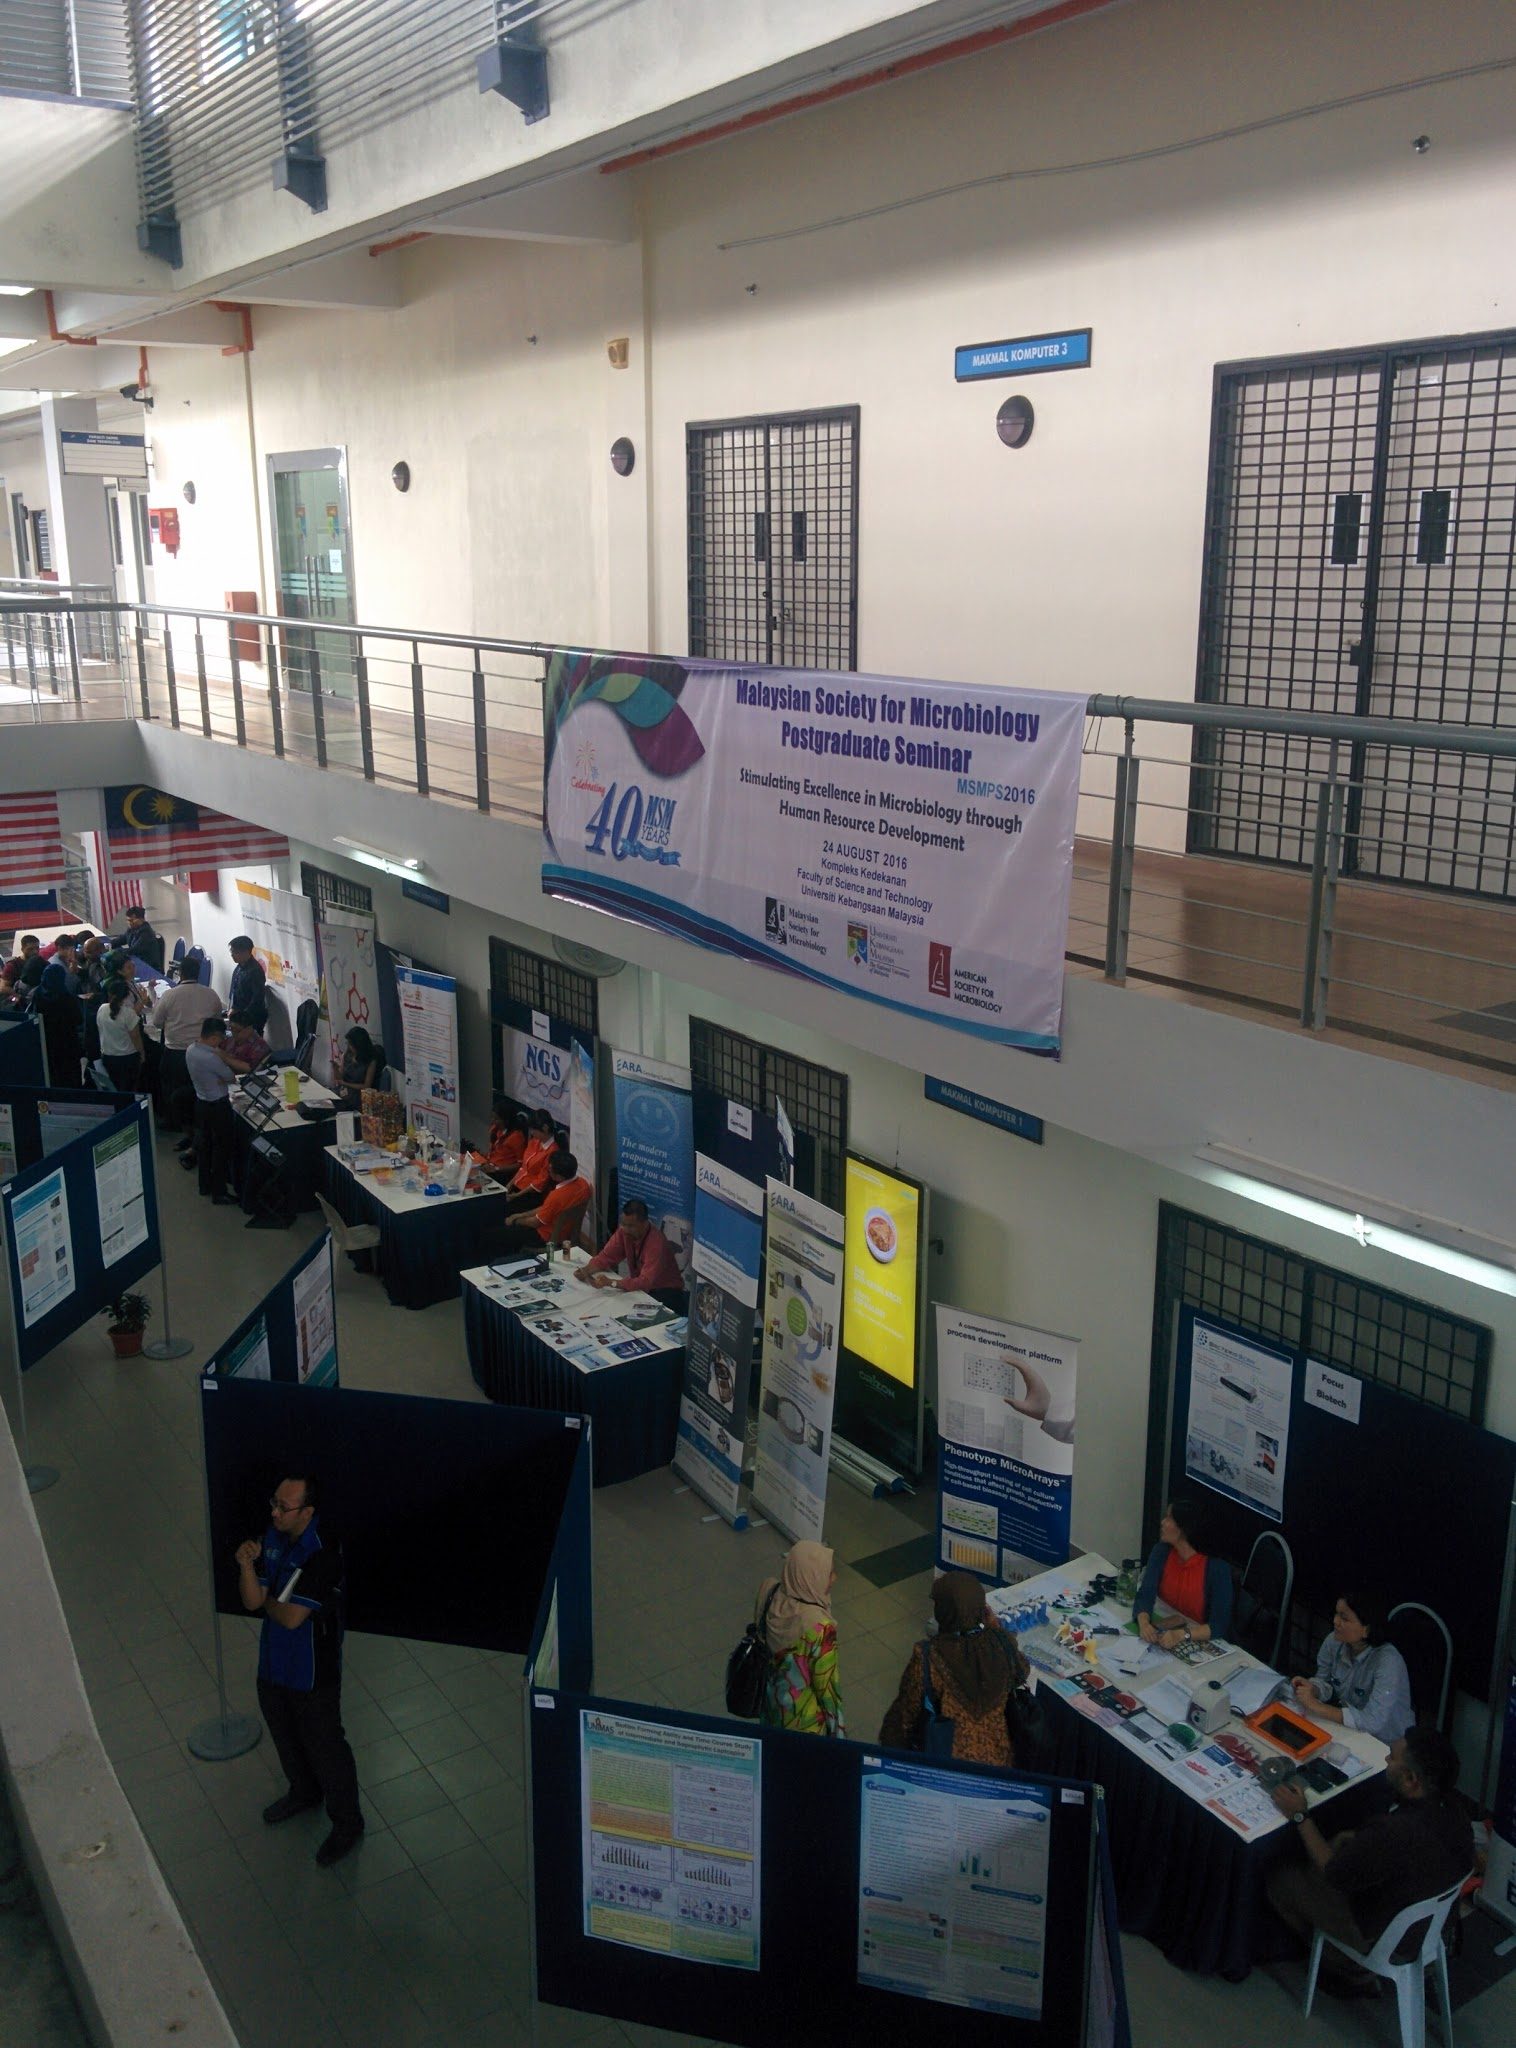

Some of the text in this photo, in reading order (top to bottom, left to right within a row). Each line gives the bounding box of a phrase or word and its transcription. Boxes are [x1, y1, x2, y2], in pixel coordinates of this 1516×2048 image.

[972, 342, 1068, 366] MAKMAL KOMPUTER 3
[736, 679, 1040, 743] Malaysian Society for Microbiology
[781, 721, 972, 774] Postgraduate Seminar
[740, 768, 1022, 834] Stimulating Excellence in Microbiology through
[957, 778, 1036, 805] MSMPS2016
[585, 782, 644, 861] 40
[644, 795, 677, 830] MSM
[641, 825, 670, 846] YEARS
[780, 800, 965, 851] Human Resource Development
[823, 840, 907, 870] 24 AUGUST 2016
[821, 858, 906, 888] Kompleks Kedekanan
[797, 868, 934, 914] Faculty of Science and Technology
[788, 908, 819, 924] Malaysian
[801, 884, 924, 926] Universiti Kebangsaan Malaysia
[788, 920, 820, 938] Society for
[788, 933, 827, 956] Microbiology
[954, 968, 987, 984] AMERICAN
[954, 981, 994, 999] SOCIETY FOR
[954, 993, 1002, 1015] MICROBIOLOGY
[527, 1042, 560, 1082] NGS
[940, 1084, 972, 1107] MAKMAL
[974, 1099, 1017, 1125] KOMPUTER
[622, 1136, 668, 1158] The modern
[622, 1152, 672, 1172] evaporator to
[622, 1163, 680, 1188] make you smile
[947, 1328, 1062, 1365] process development platform
[1322, 1374, 1344, 1390] Focus
[1316, 1389, 1347, 1409] Biotech
[944, 1442, 997, 1465] Phenotype
[1033, 1490, 1055, 1501] culture
[588, 1722, 614, 1734] UNIMAS
